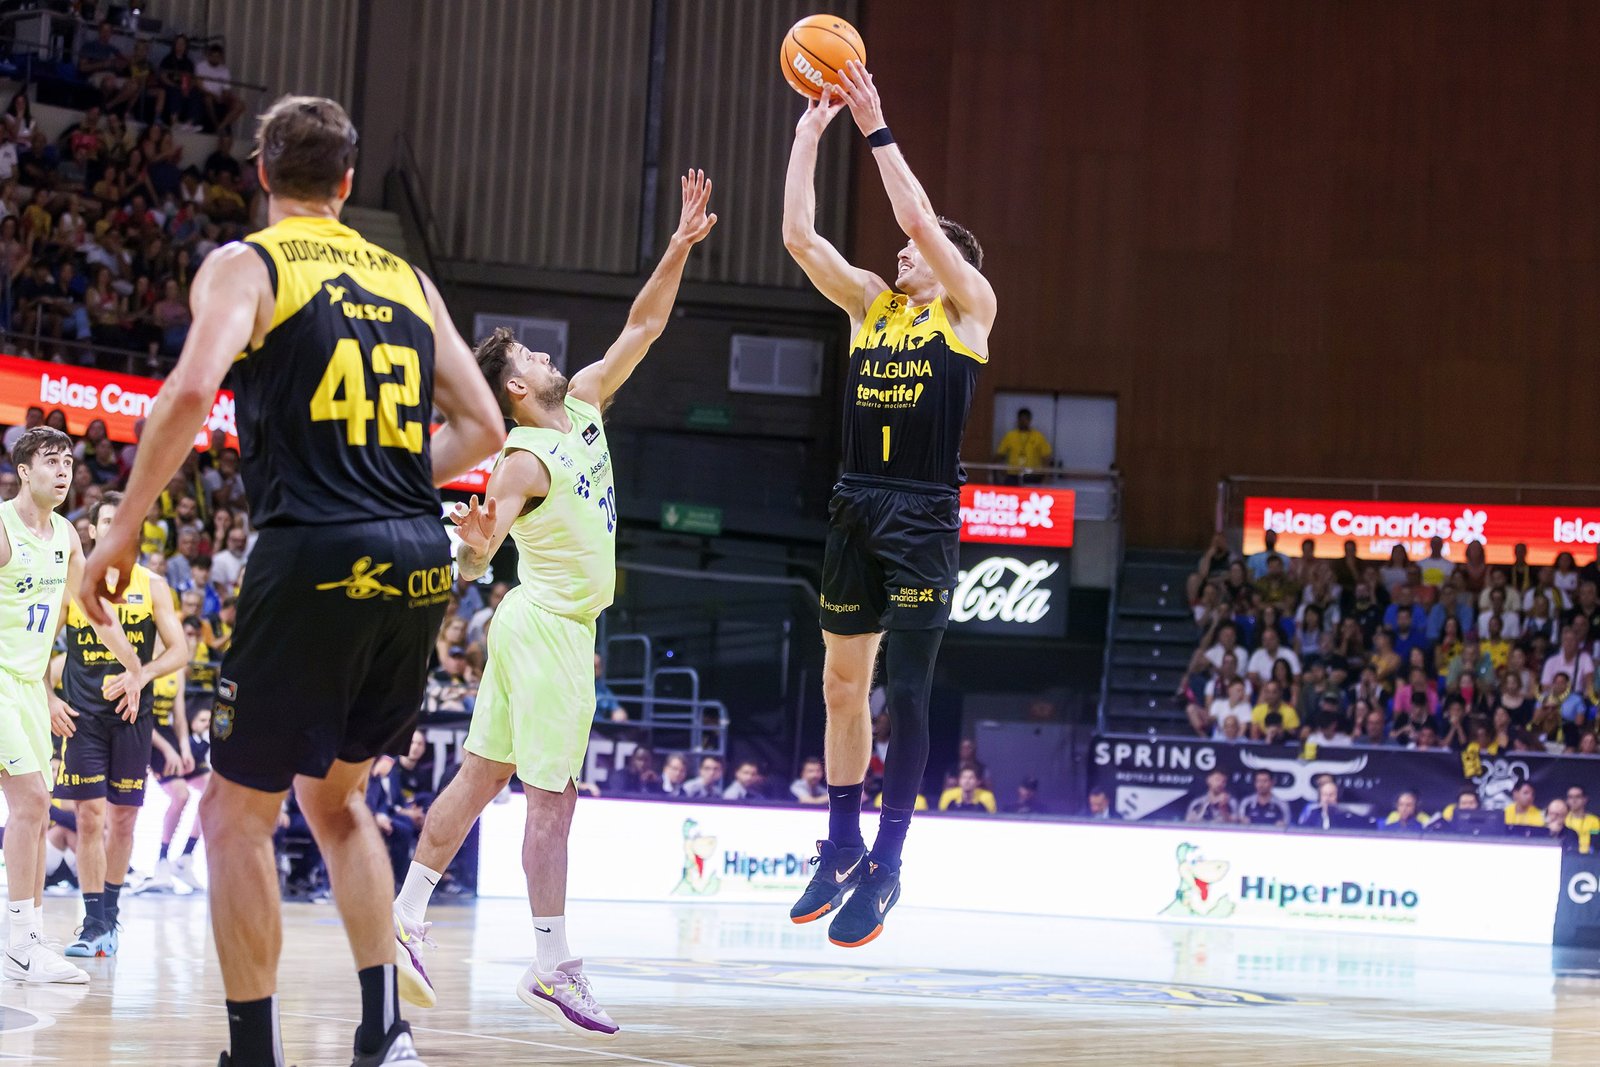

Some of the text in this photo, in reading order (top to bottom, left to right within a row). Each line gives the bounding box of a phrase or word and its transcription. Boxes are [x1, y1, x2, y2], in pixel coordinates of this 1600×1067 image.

[41, 373, 98, 410] Islas
[310, 338, 424, 454] 42
[881, 425, 891, 462] 1
[599, 486, 617, 533] 20
[974, 490, 1019, 511] Islas
[959, 507, 1019, 526] narias
[1263, 507, 1451, 540] Islas Canarias
[1553, 517, 1600, 545] Isla
[824, 601, 860, 614] Hospiten
[891, 594, 918, 603] anarias
[26, 603, 50, 633] 17
[77, 632, 94, 645] LA
[1095, 742, 1217, 771] SPRING
[1240, 875, 1418, 908] HiperDino
